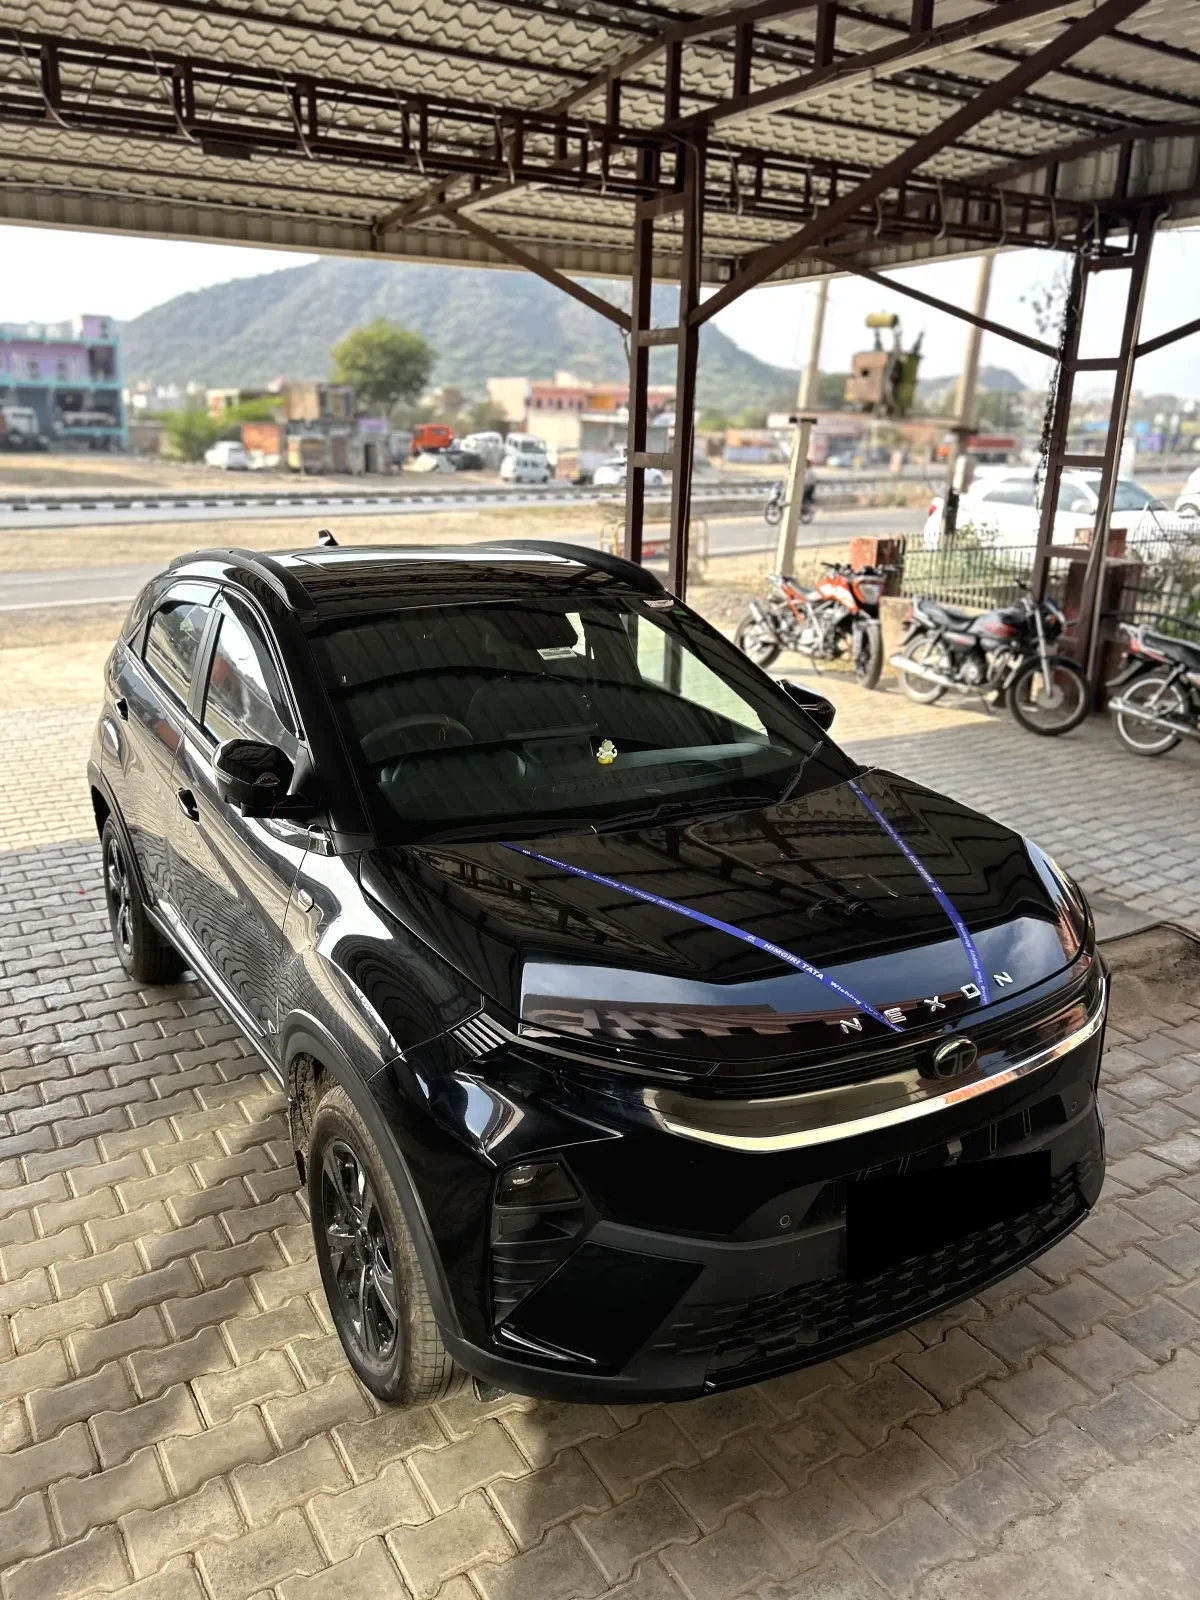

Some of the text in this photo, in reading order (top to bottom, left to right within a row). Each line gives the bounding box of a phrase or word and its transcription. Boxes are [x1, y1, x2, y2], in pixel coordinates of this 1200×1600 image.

[763, 943, 801, 966] HIMGIRI
[801, 962, 824, 981] TATA
[838, 971, 1014, 1034] NEXON
